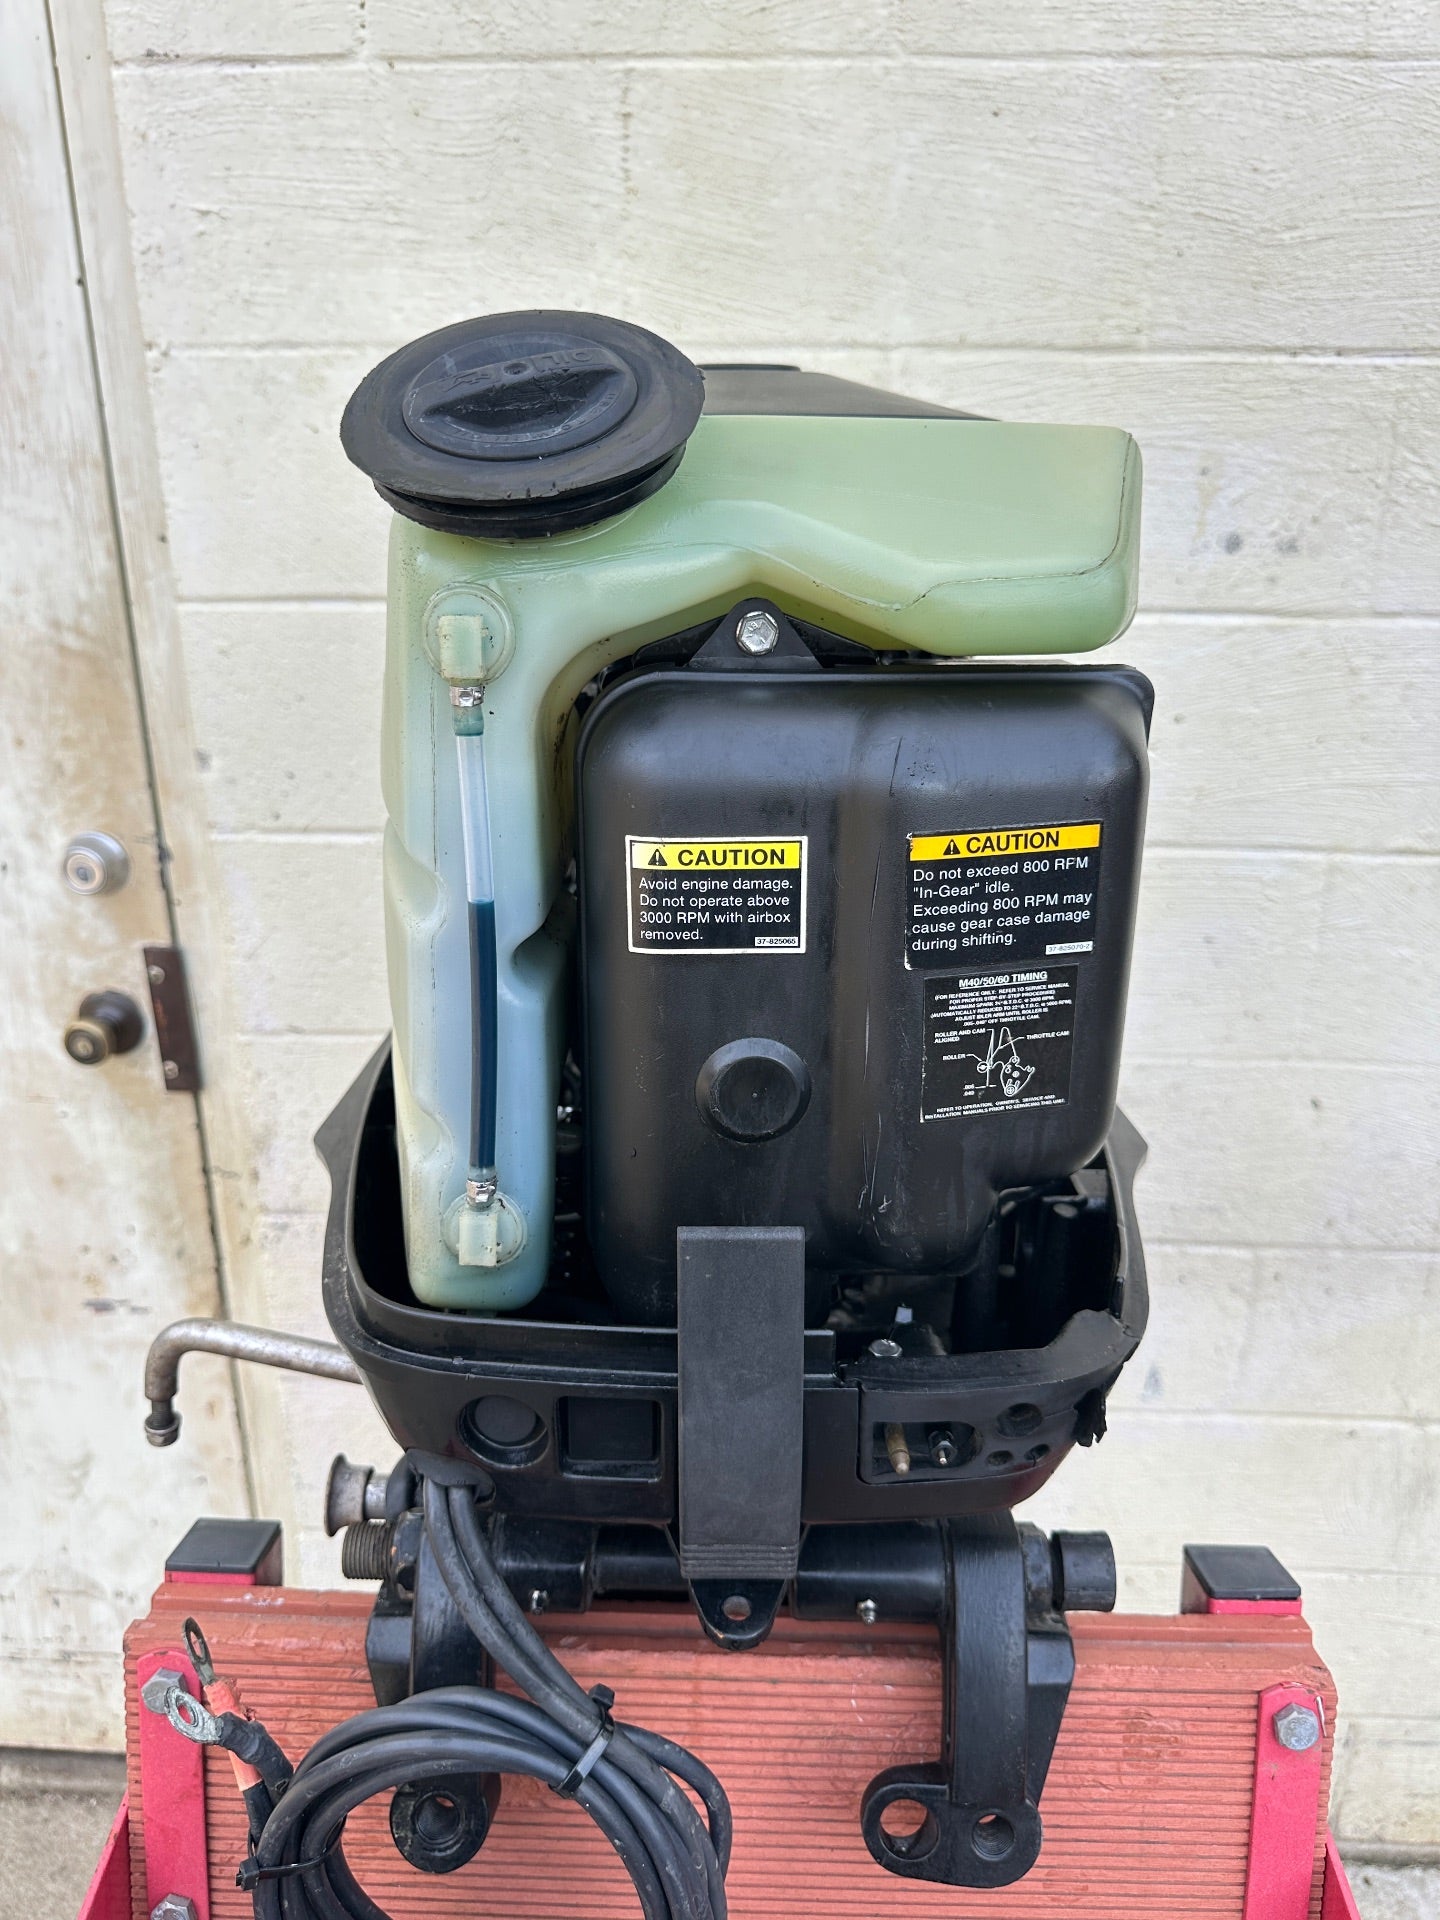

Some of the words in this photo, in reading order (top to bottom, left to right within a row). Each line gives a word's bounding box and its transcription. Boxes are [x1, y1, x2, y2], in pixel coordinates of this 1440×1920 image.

[966, 830, 1060, 854] CAUTION
[677, 848, 785, 866] CAUTION
[913, 869, 934, 882] Do
[939, 867, 962, 880] not
[966, 862, 1018, 877] exceed
[1023, 859, 1050, 873] 800
[1054, 856, 1089, 871] RPM
[639, 877, 677, 890] Avoid
[681, 878, 729, 892] engine
[732, 878, 793, 892] damage.
[913, 882, 980, 899] "In-Gear"
[985, 881, 1014, 894] idle.
[640, 894, 658, 907] Do
[662, 895, 685, 907] not
[689, 895, 743, 910] operate
[747, 895, 790, 906] above
[913, 899, 988, 917] Exceeding
[993, 897, 1020, 910] 800
[1024, 894, 1059, 908] RPM
[1063, 892, 1093, 906] may
[640, 912, 672, 924] 3000
[676, 912, 710, 924] RPM
[714, 911, 743, 923] with
[747, 911, 791, 923] airbox
[911, 922, 956, 934] cause
[960, 919, 993, 933] gear
[996, 914, 1030, 927] case
[1034, 909, 1091, 925] damage
[640, 929, 703, 940] removed.
[911, 936, 957, 952] during
[961, 932, 1017, 947] shifting.
[958, 974, 1010, 988] M40/50/60
[1012, 971, 1048, 983] TIMING
[1026, 1031, 1055, 1039] THROTTLE
